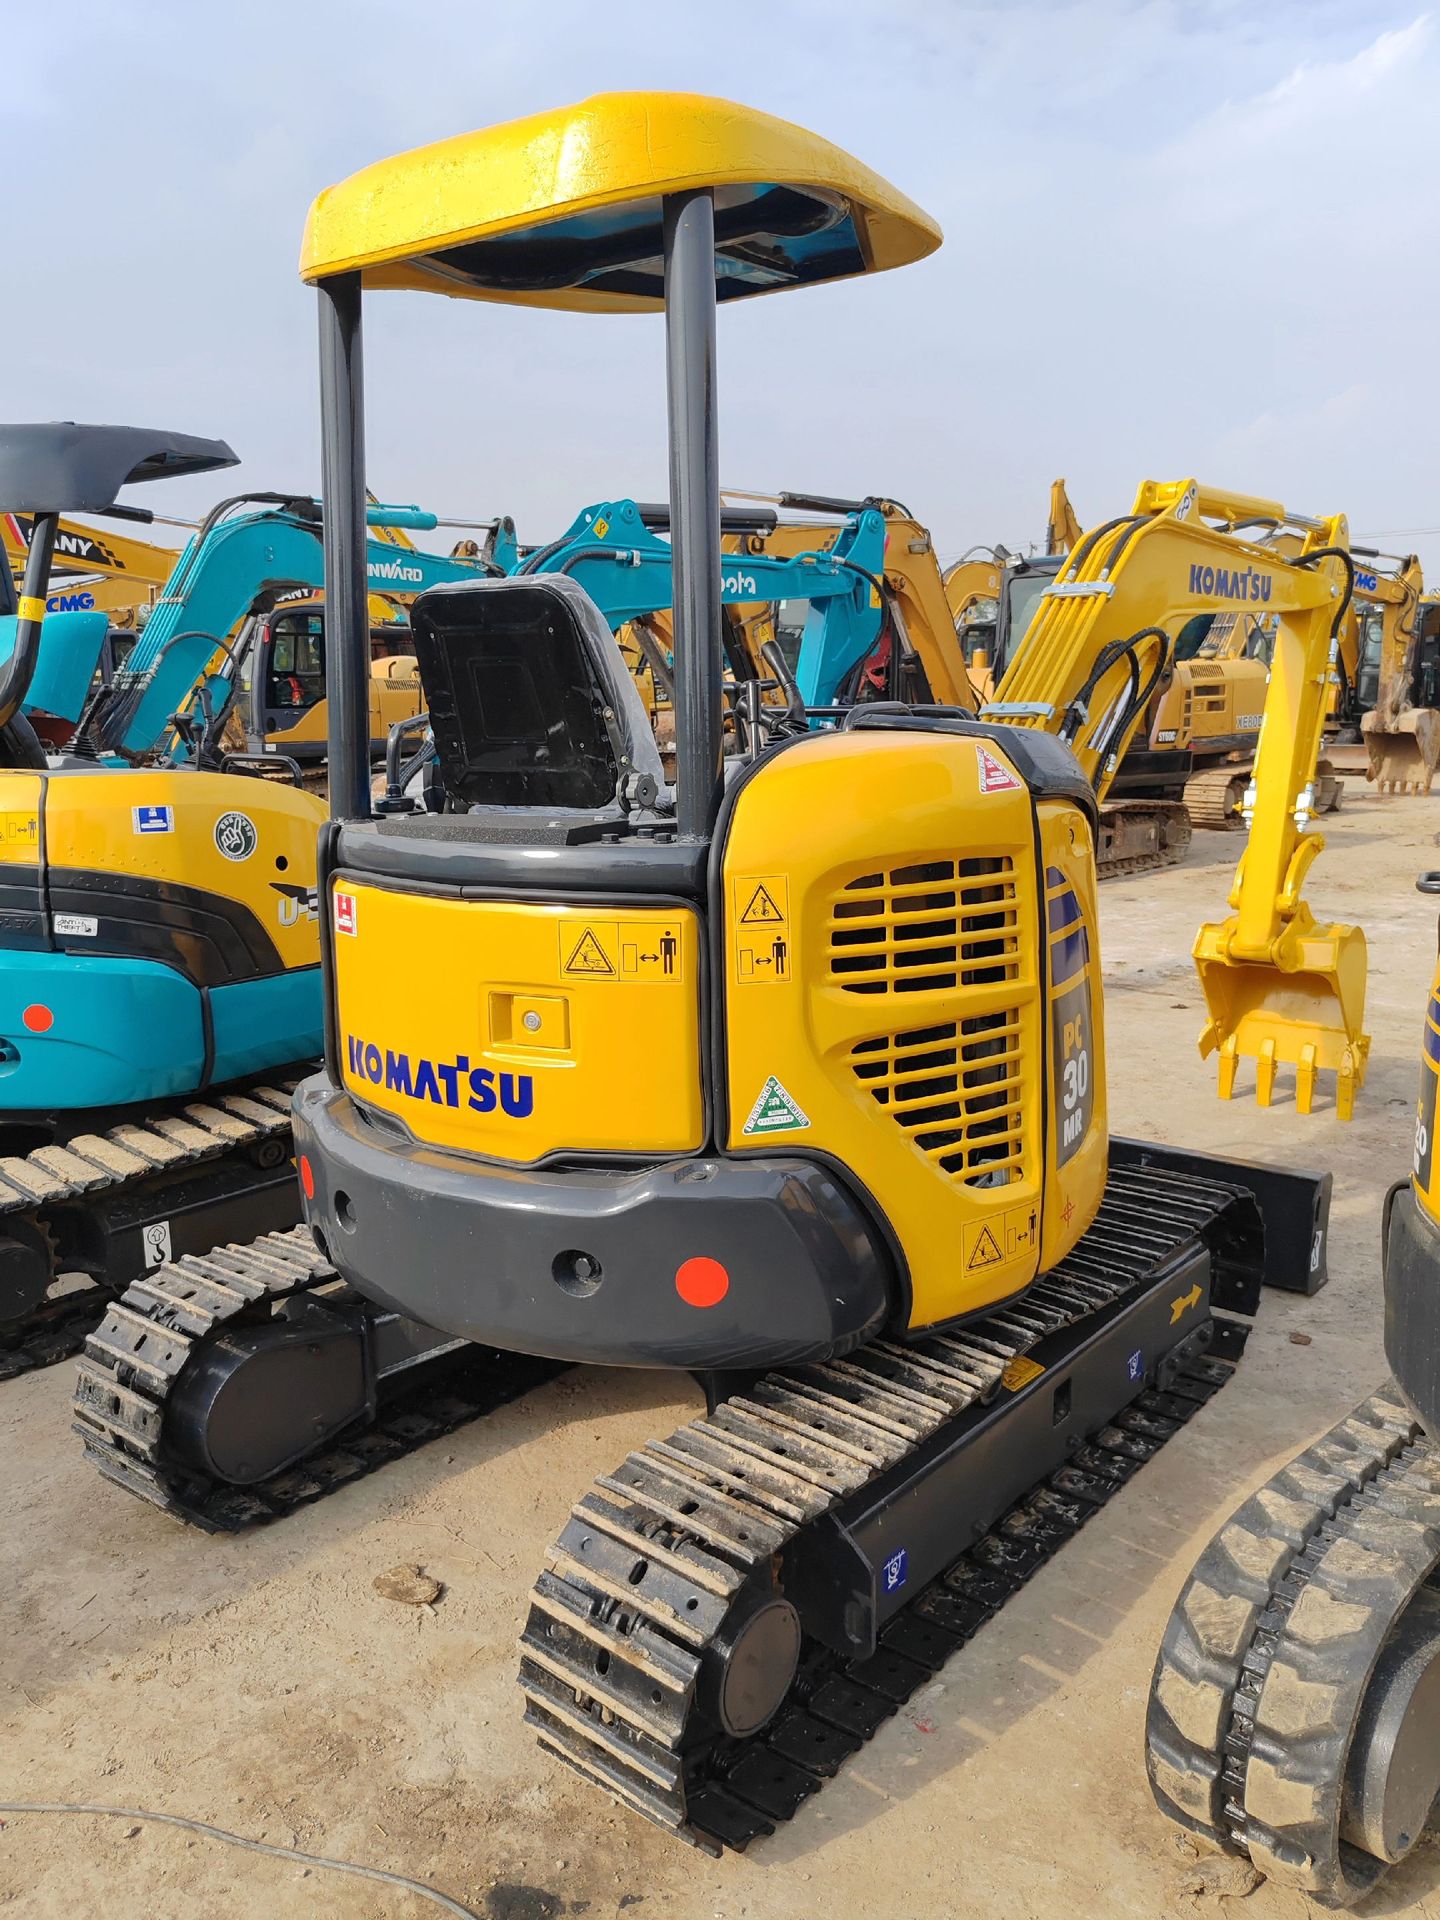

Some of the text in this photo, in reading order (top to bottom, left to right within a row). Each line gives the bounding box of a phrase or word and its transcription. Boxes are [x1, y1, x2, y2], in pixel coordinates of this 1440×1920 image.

[367, 559, 423, 582] NWARD
[1189, 564, 1272, 602] KOMATSU
[1352, 571, 1377, 592] MG
[1063, 1013, 1082, 1060] PC
[348, 1035, 534, 1118] KOMATSU
[1063, 1050, 1088, 1110] 30
[1063, 1107, 1082, 1148] MR
